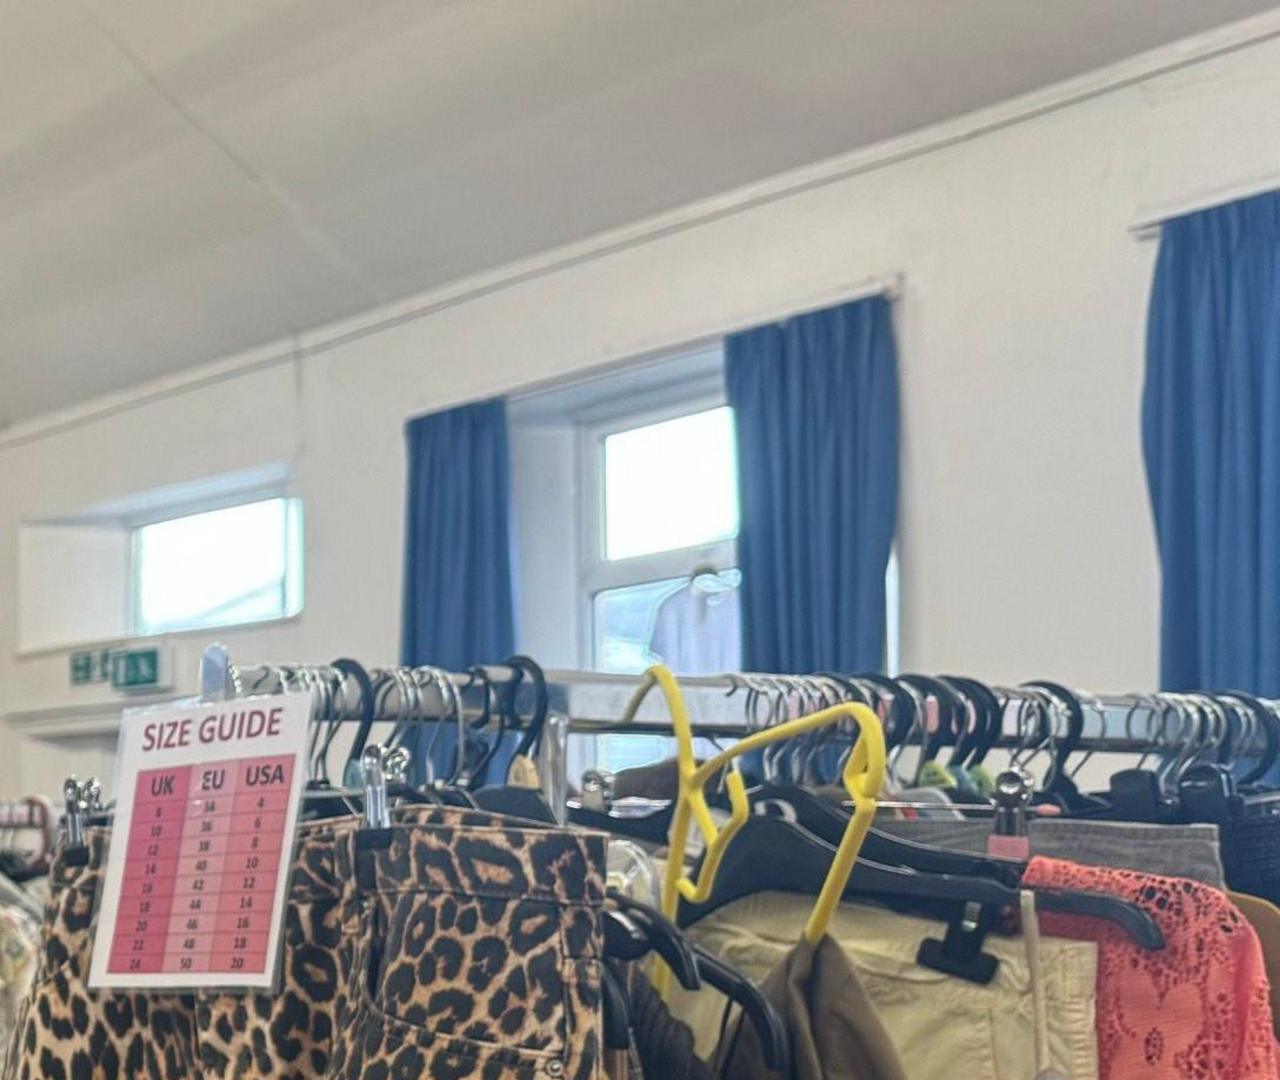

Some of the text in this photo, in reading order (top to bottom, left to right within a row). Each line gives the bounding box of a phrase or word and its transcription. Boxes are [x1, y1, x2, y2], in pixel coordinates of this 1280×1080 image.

[142, 707, 283, 752] SIZE GUIDE
[151, 764, 284, 796] UK EU USA
[147, 844, 158, 856] 12
[145, 857, 258, 875] 14 40 10
[192, 879, 204, 891] 42
[242, 876, 255, 889] 12
[189, 898, 201, 911] 44
[239, 896, 252, 909] 14
[186, 918, 199, 931] 46
[237, 916, 250, 929] 16
[233, 936, 247, 949] 18
[179, 957, 192, 970] 50
[230, 957, 244, 969] 20
